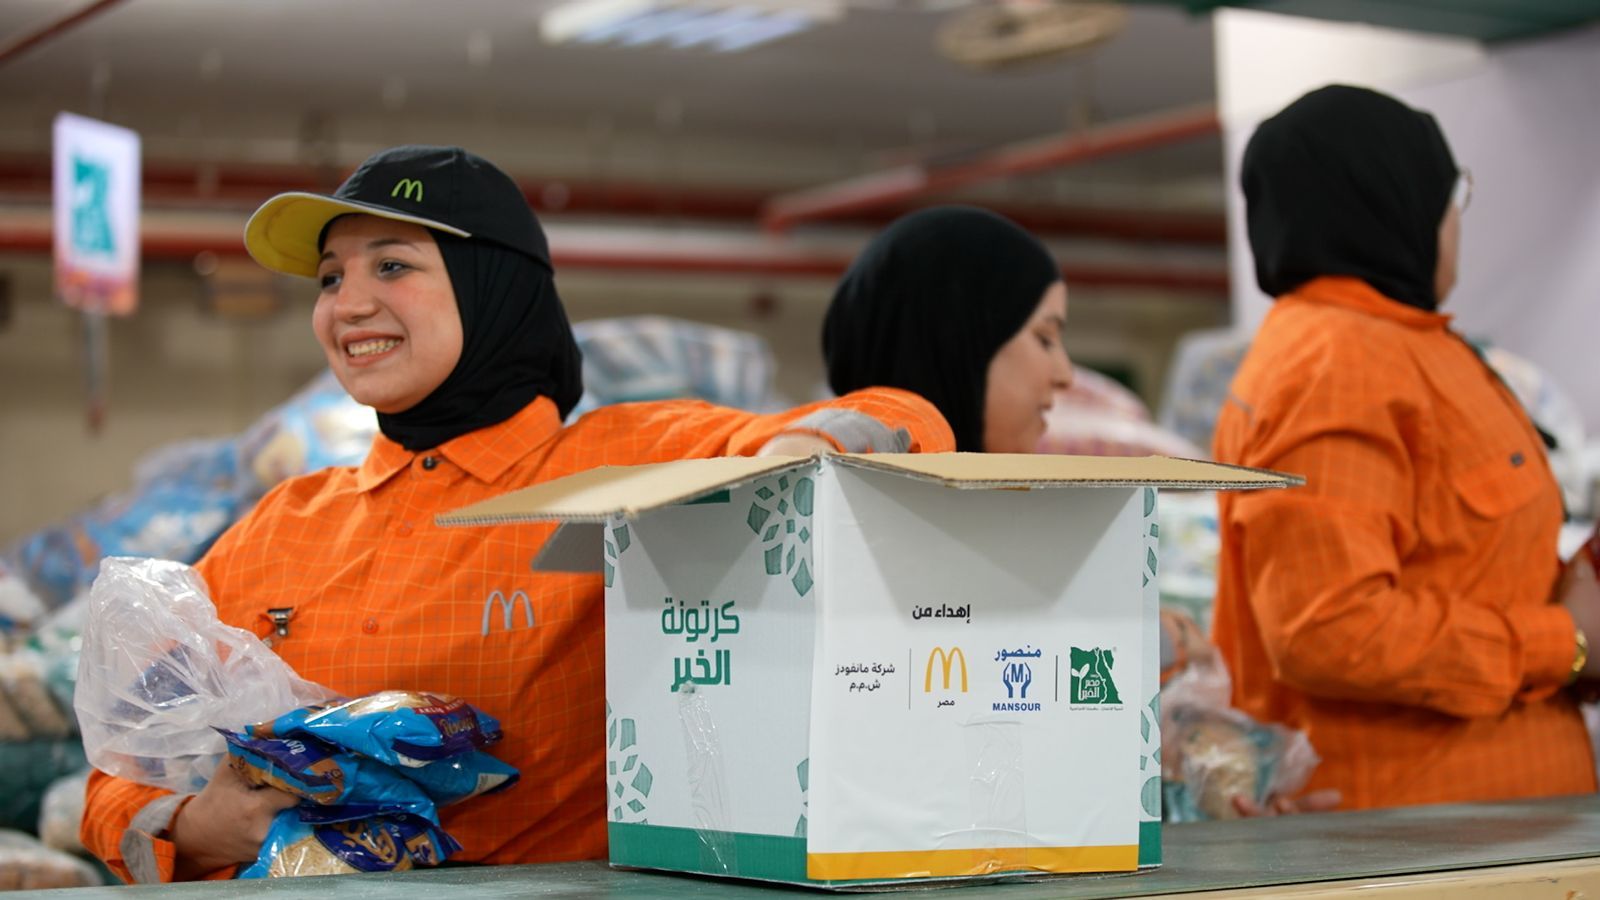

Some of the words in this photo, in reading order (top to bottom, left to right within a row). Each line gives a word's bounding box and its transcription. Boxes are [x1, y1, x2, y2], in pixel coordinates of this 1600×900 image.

[661, 597, 740, 642] كرتونة
[912, 605, 932, 620] من
[934, 603, 971, 624] إهداء
[994, 645, 1042, 661] منصور
[671, 649, 731, 693] الخير
[872, 663, 896, 676] شركة
[937, 699, 956, 708] مصر
[992, 702, 1041, 712] MANSOUR
